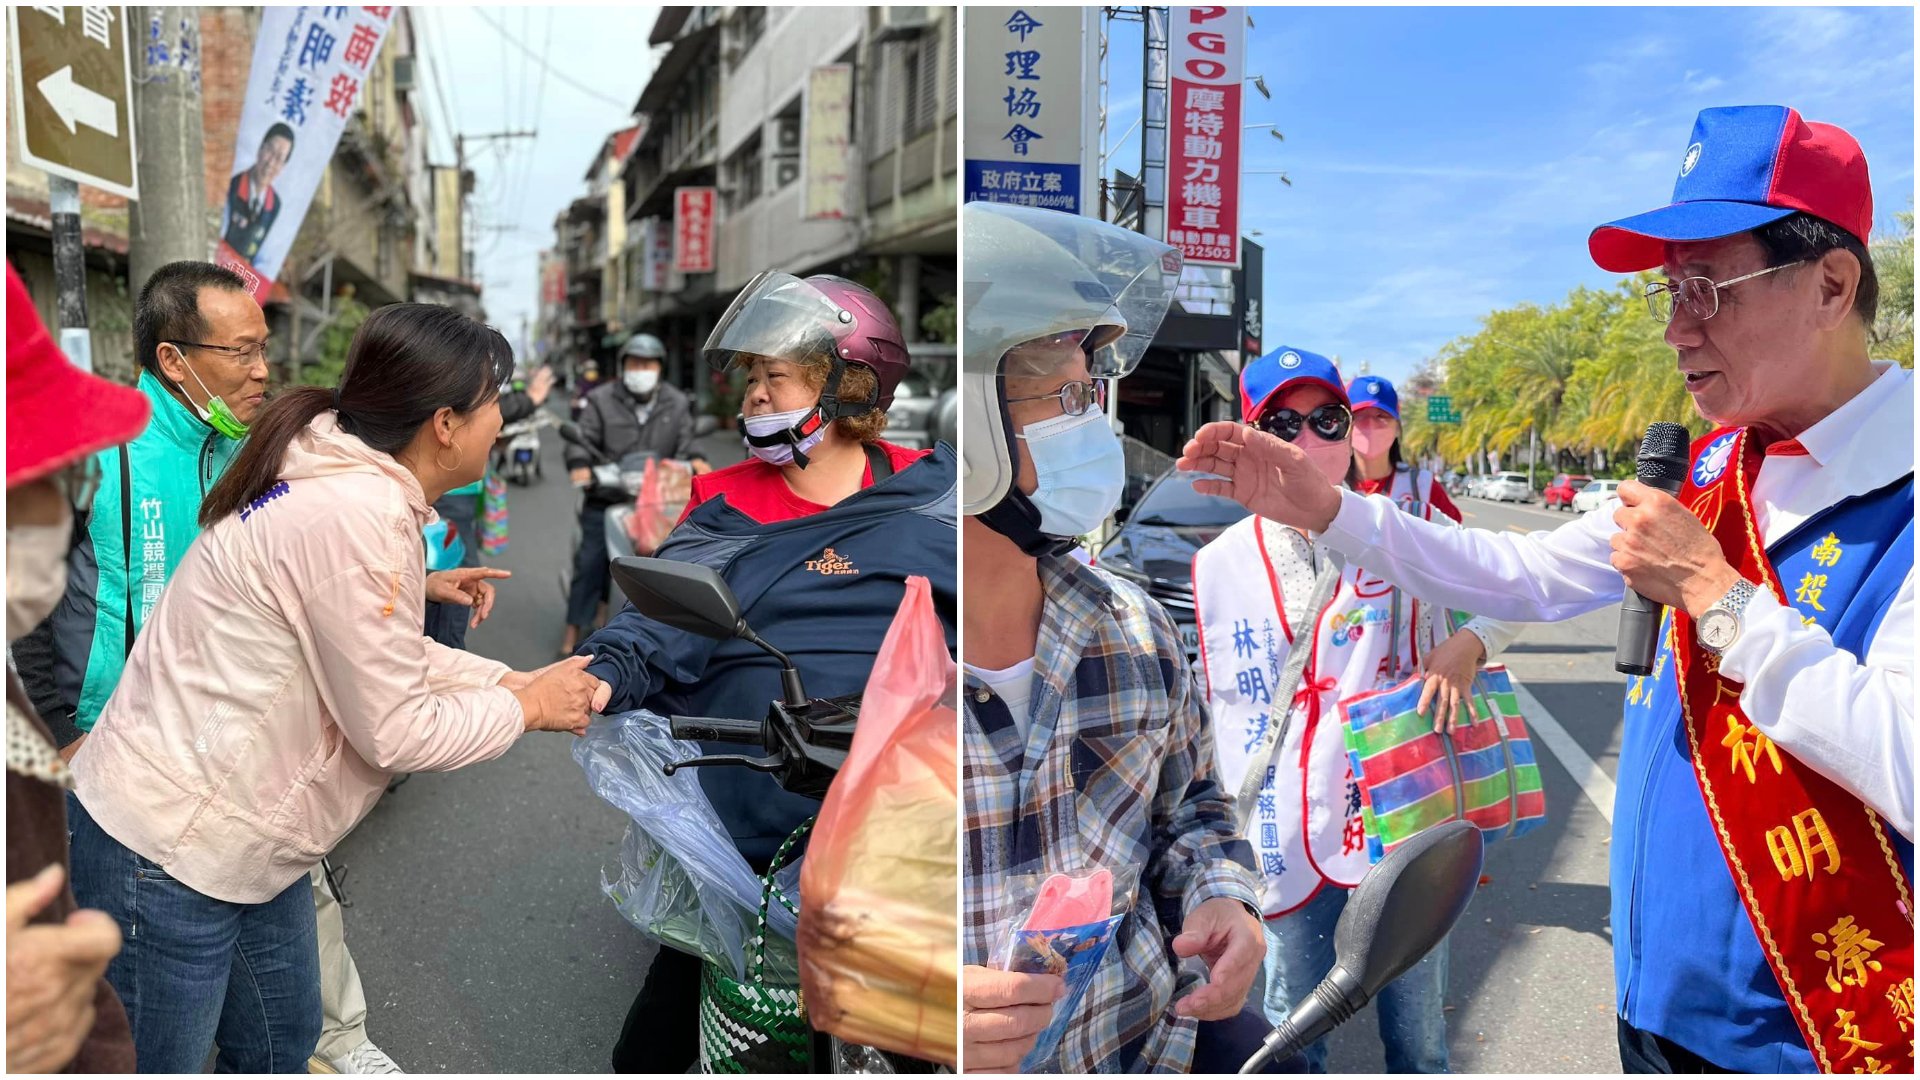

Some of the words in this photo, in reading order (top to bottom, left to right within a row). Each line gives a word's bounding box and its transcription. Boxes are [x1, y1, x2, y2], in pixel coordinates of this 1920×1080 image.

[1001, 10, 1044, 156] 命理協會
[981, 169, 1063, 193] 政府立案
[1181, 87, 1225, 230] 摩特動力機車
[1171, 243, 1232, 260] 232503
[804, 559, 854, 575] Tiger
[1795, 531, 1843, 627] 南投
[1257, 765, 1287, 876] 服務團隊
